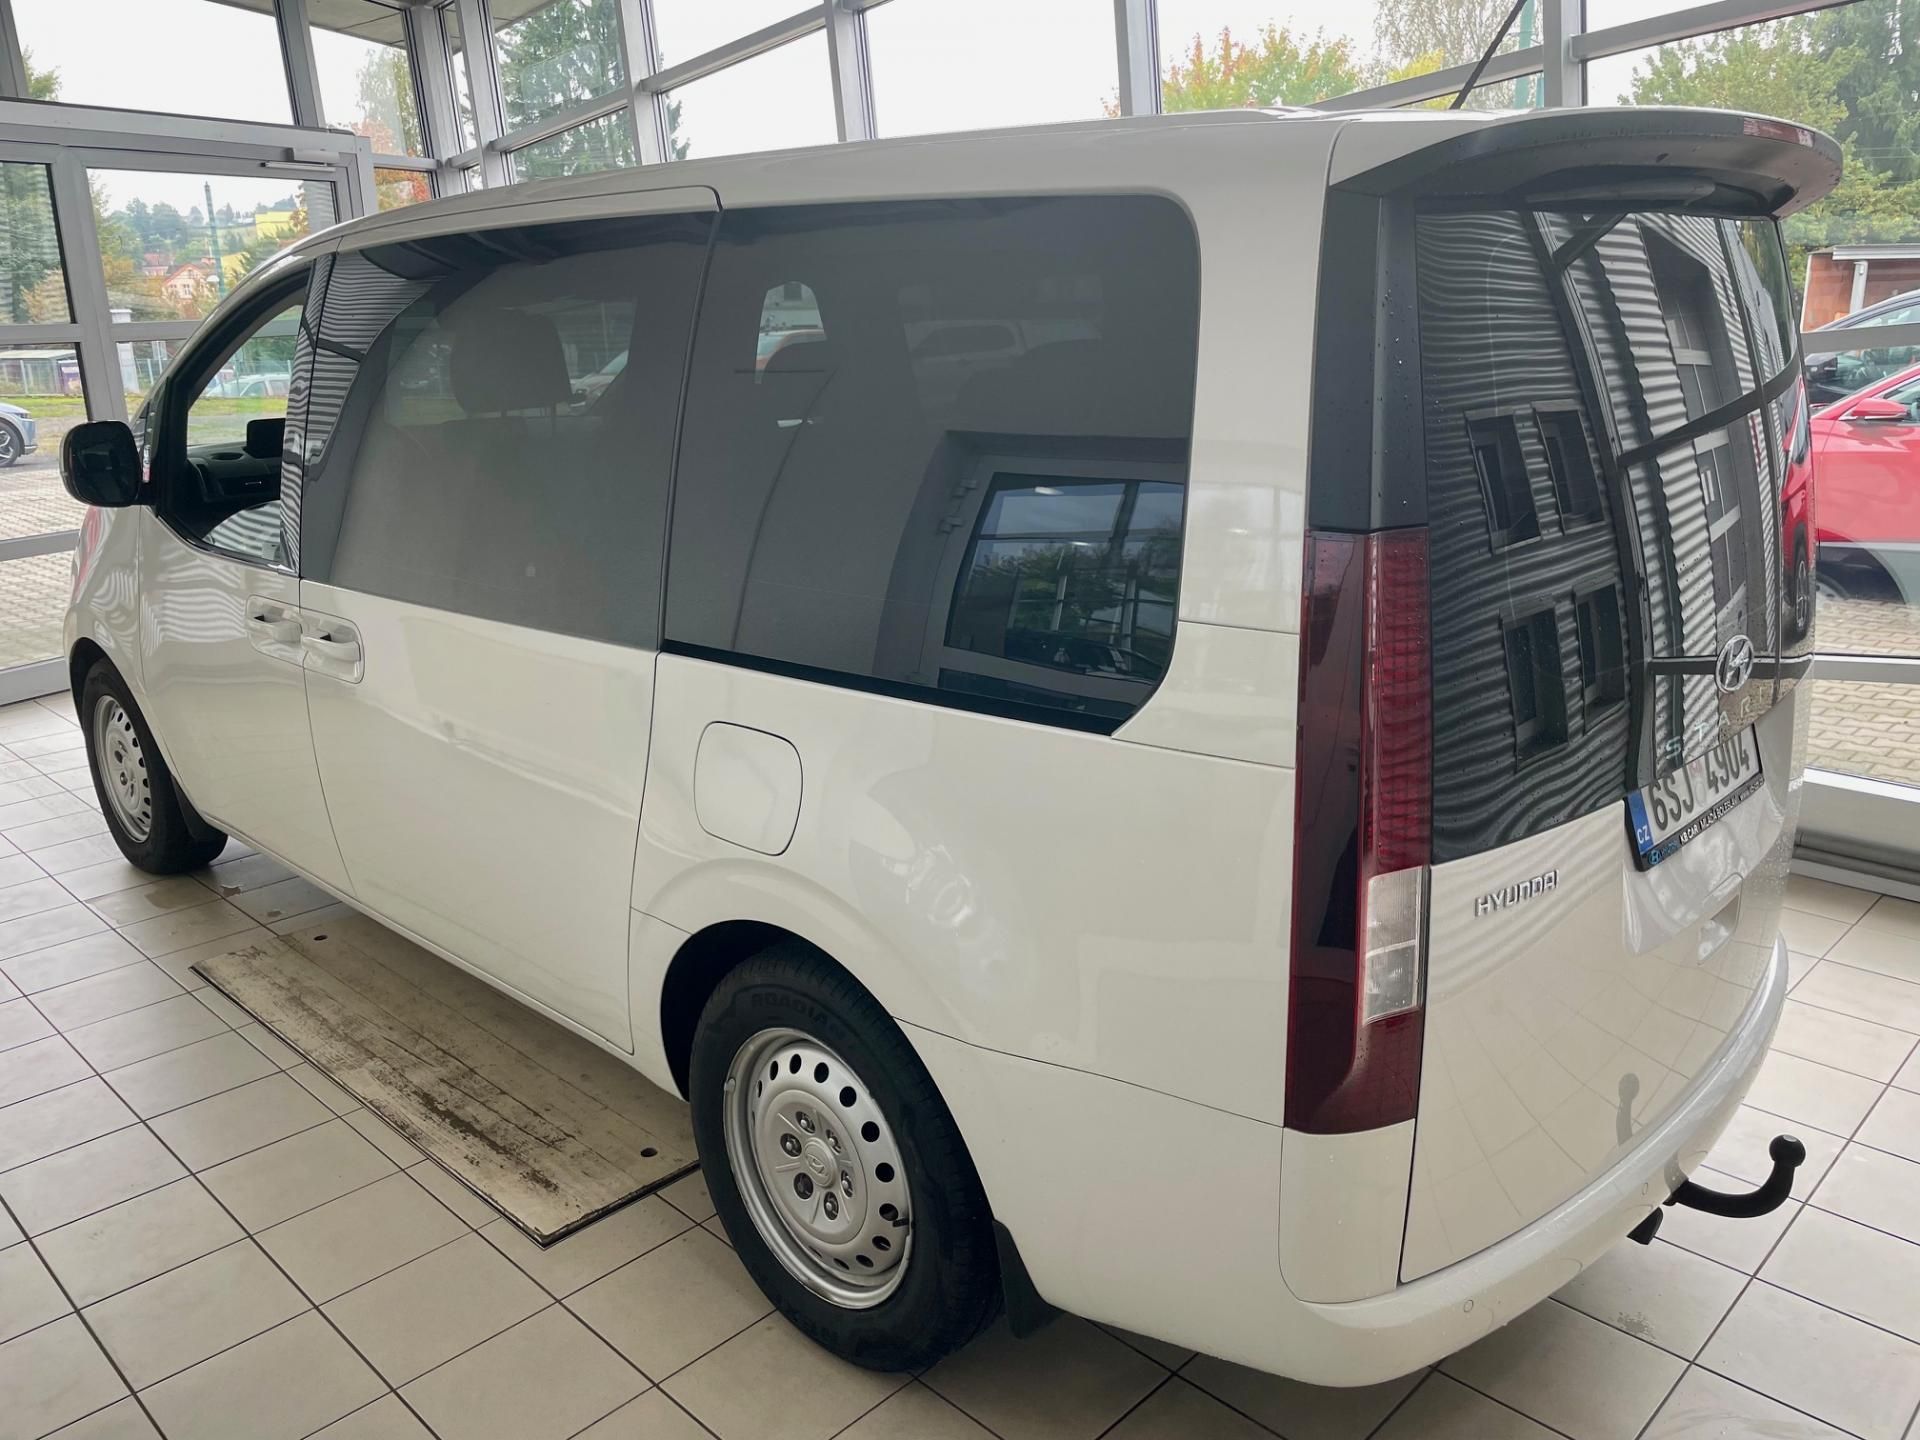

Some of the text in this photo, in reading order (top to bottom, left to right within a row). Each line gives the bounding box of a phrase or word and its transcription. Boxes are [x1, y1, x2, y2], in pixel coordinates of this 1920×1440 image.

[1665, 682, 1775, 761] STARI
[1649, 731, 1750, 831] 6SJ 4904
[1637, 825, 1650, 844] CZ
[1475, 869, 1559, 917] HYUNDAI
